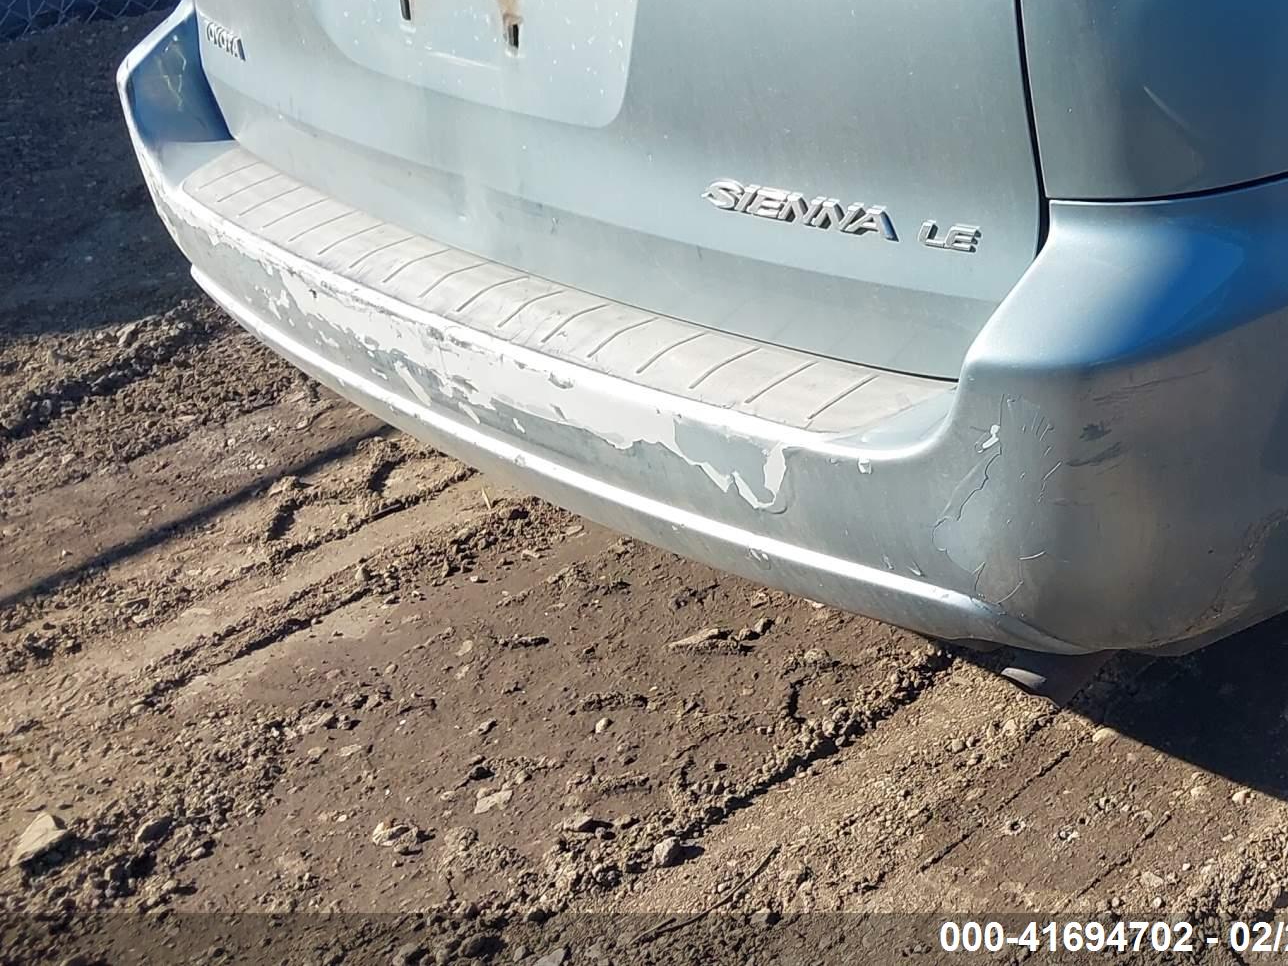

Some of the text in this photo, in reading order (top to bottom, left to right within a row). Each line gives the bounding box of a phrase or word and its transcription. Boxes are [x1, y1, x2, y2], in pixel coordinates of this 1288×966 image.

[203, 17, 247, 62] OYOTA
[701, 177, 982, 252] SIENNA LE
